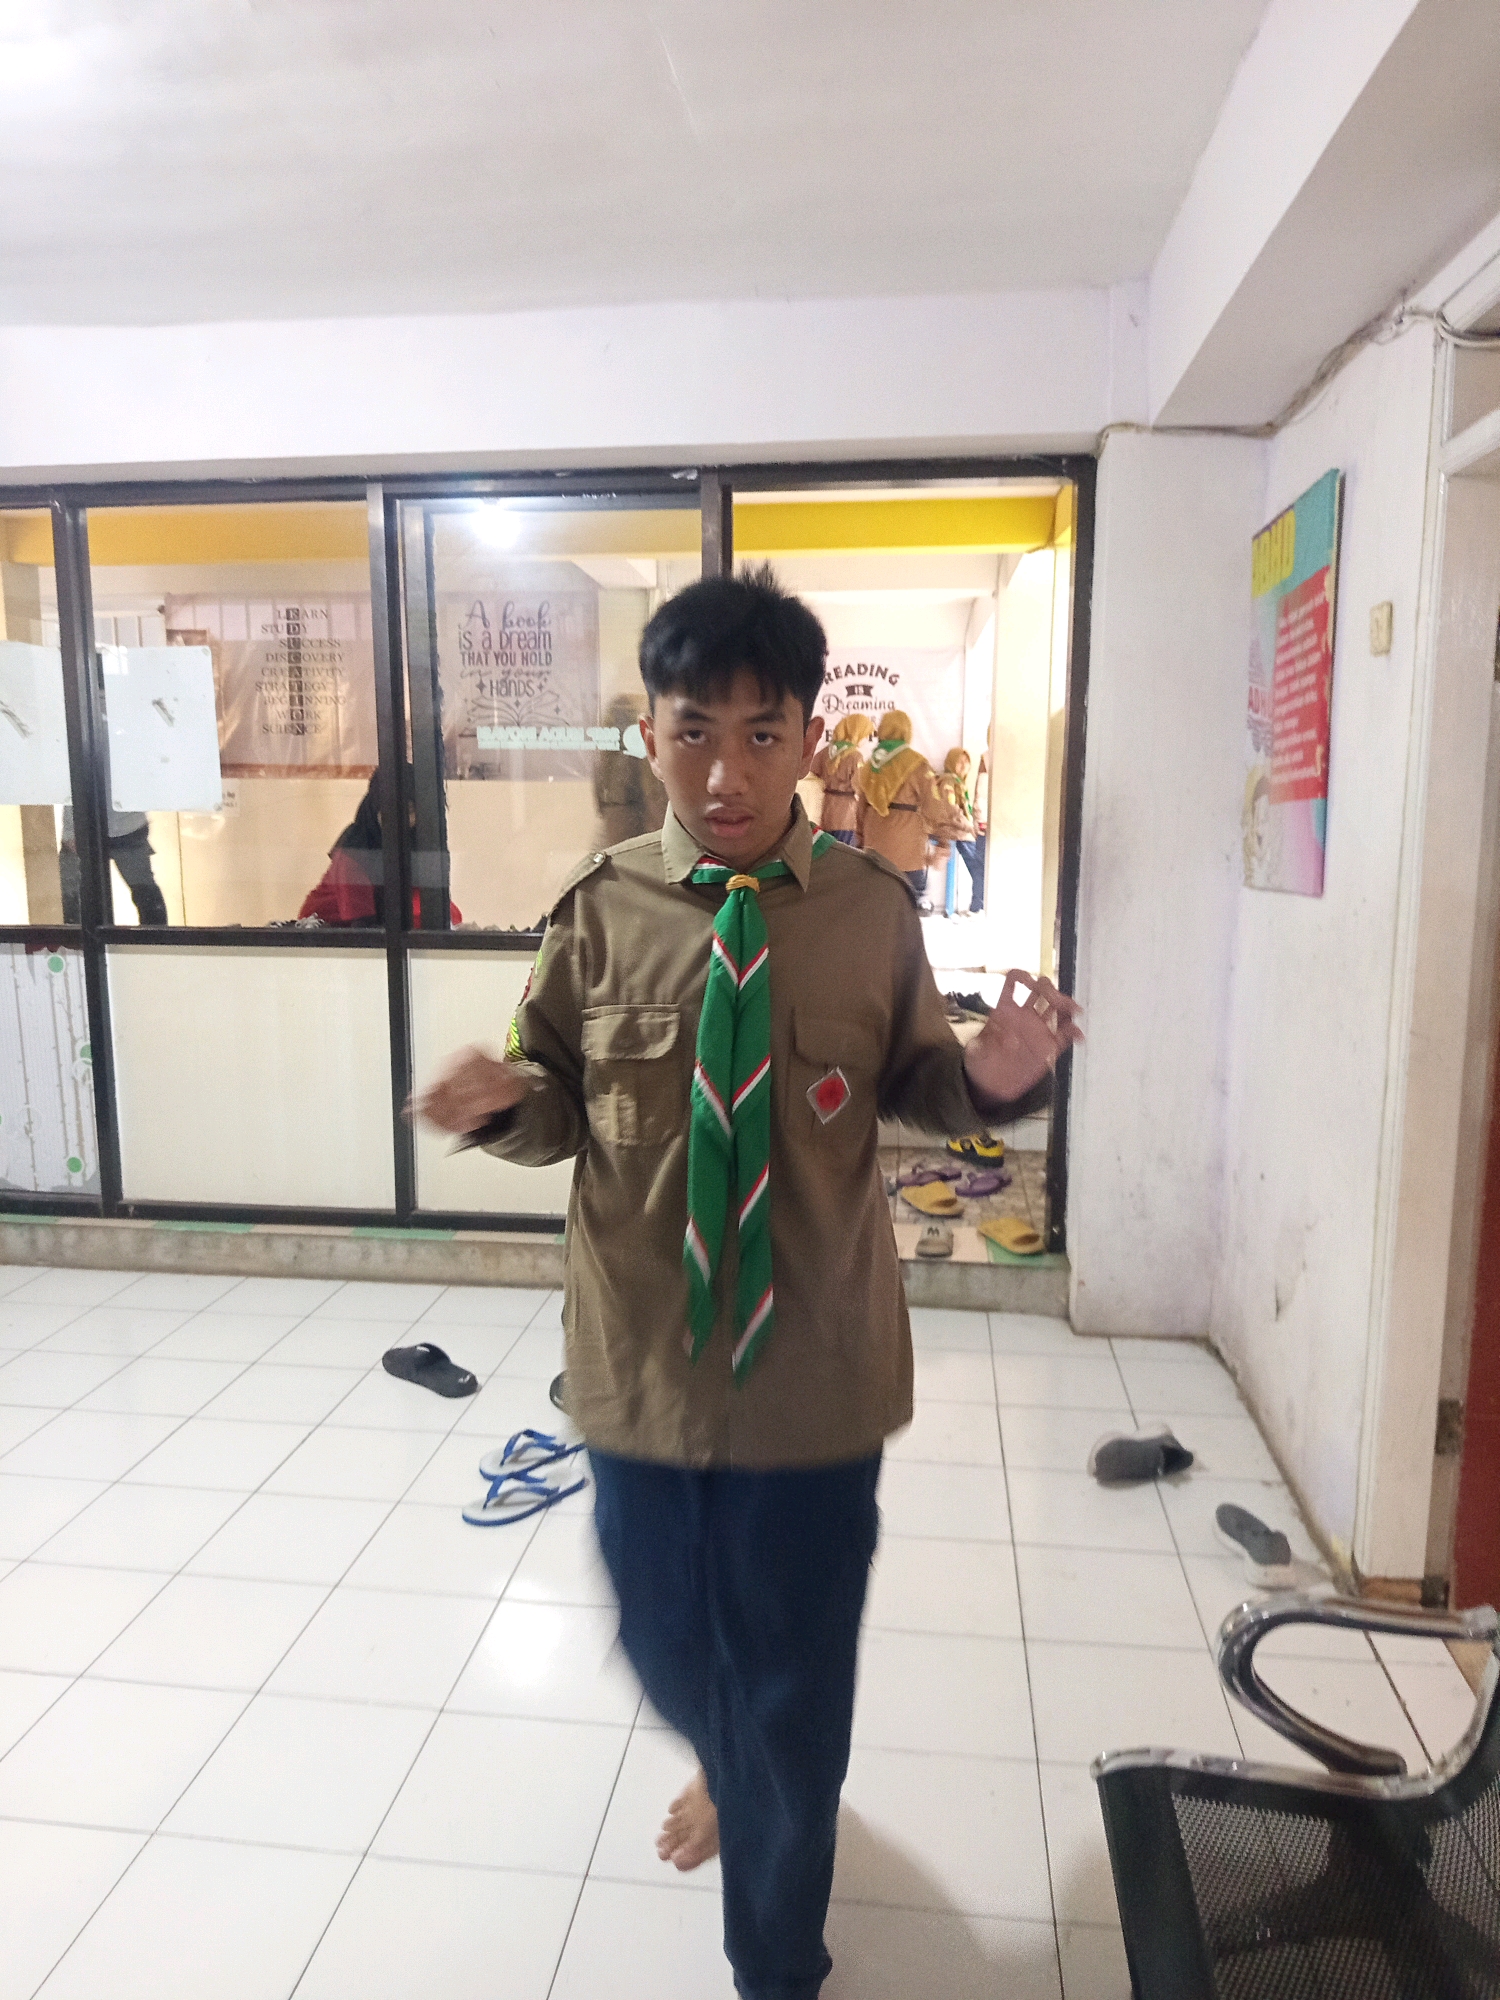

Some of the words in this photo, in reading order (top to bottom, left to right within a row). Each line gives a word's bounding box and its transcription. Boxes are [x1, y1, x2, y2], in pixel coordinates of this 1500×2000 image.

[277, 608, 328, 620] LEARN
[465, 600, 490, 629] A
[261, 623, 308, 635] STUDY
[280, 638, 341, 649] SUCCESS
[266, 652, 343, 664] DISCOVERY
[461, 651, 488, 667] THAT
[494, 651, 516, 666] YOU
[521, 651, 552, 666] HOLD
[262, 666, 343, 678] CREATIVITY
[823, 663, 900, 687] READING
[255, 680, 327, 692] STRATEGY
[277, 708, 322, 721] WORK
[262, 723, 322, 735] SCIENCE
